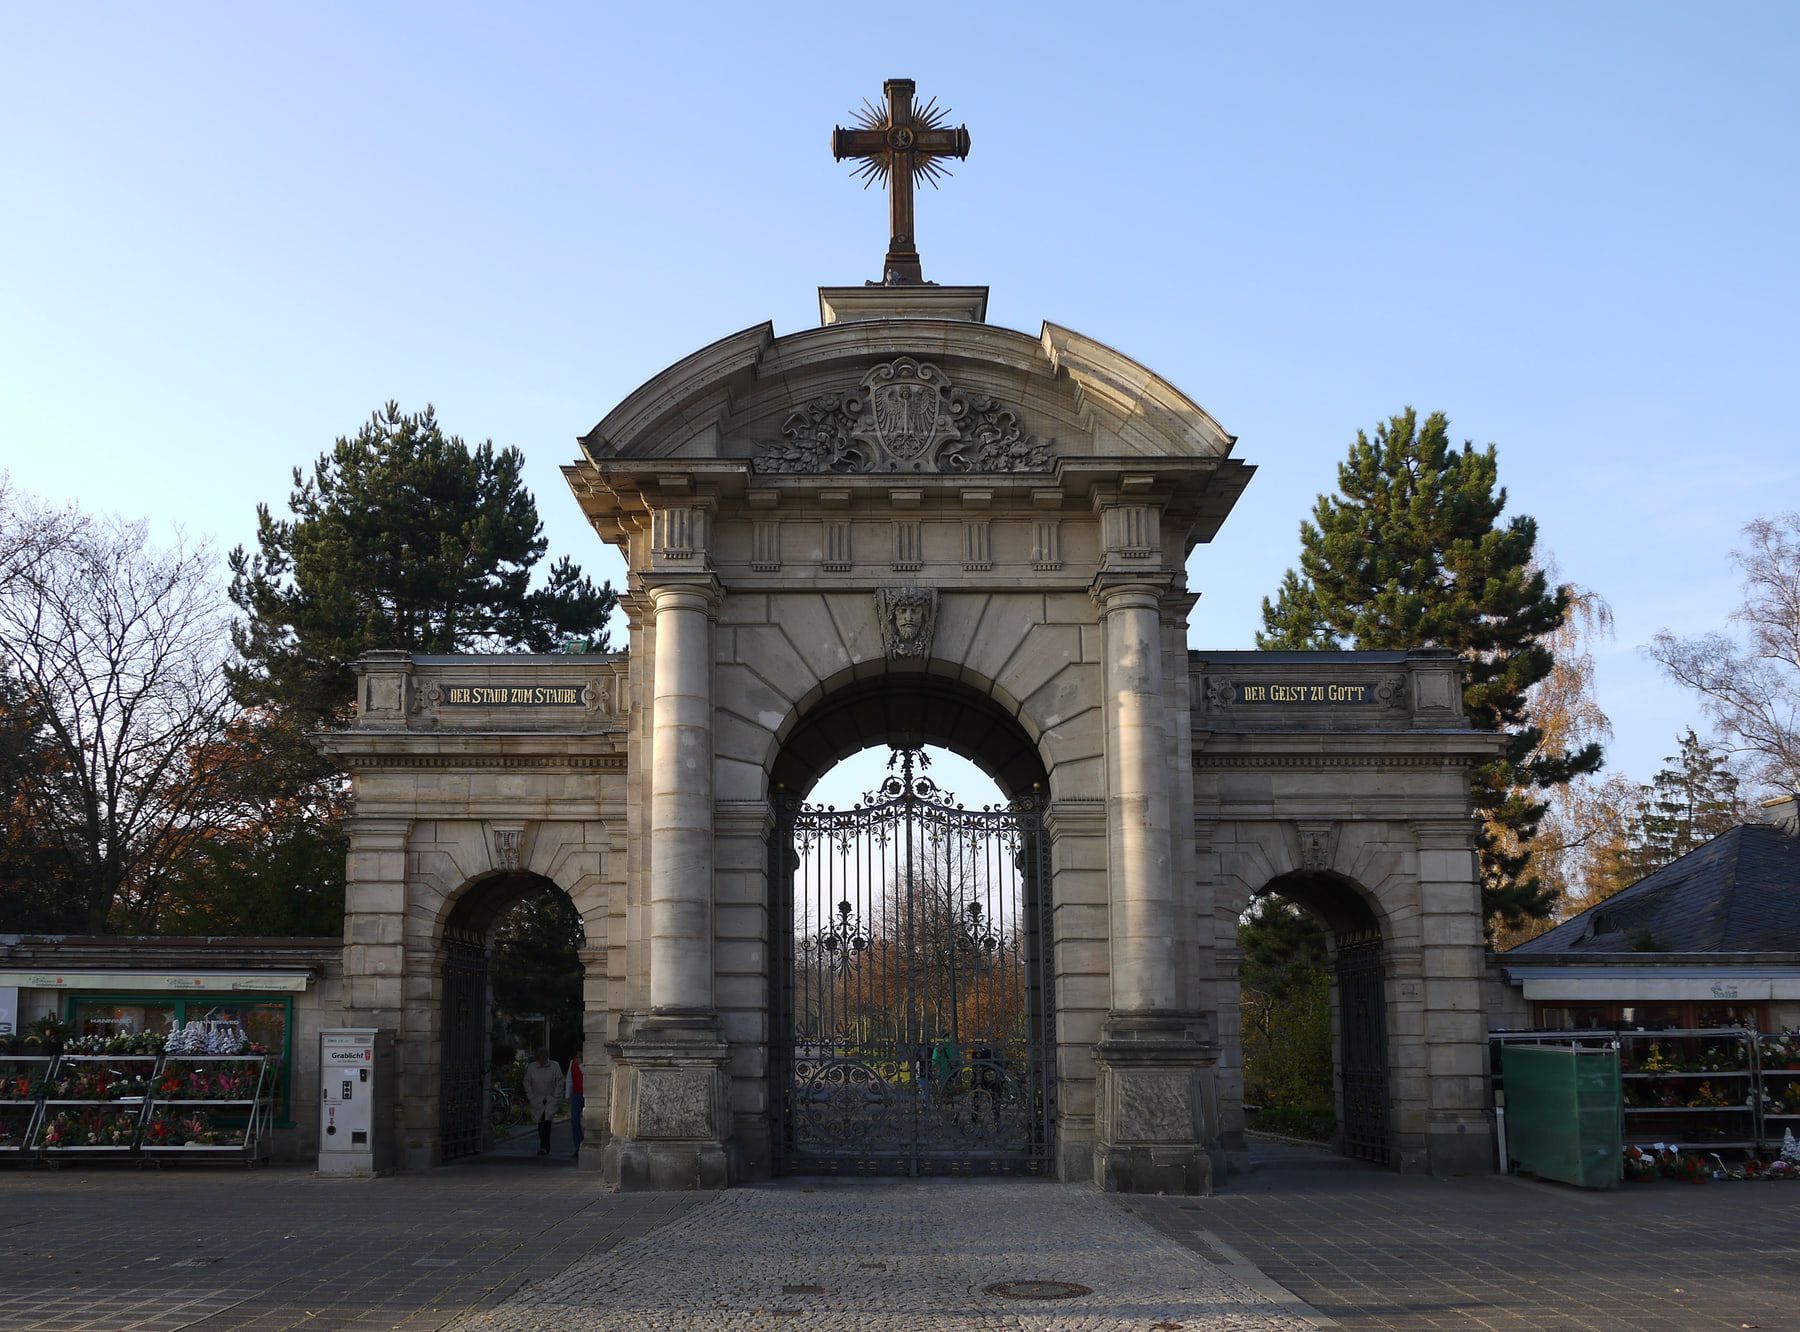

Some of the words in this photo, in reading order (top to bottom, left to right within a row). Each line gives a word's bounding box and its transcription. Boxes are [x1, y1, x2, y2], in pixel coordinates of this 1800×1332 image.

[450, 688, 470, 703] DER
[472, 687, 508, 703] STAUB
[511, 688, 533, 704] ZUM
[535, 687, 577, 704] STAUBE
[1244, 686, 1266, 701] DER
[1270, 684, 1307, 701] GEIST
[1310, 686, 1324, 701] ZU
[1328, 684, 1365, 701] GOTT
